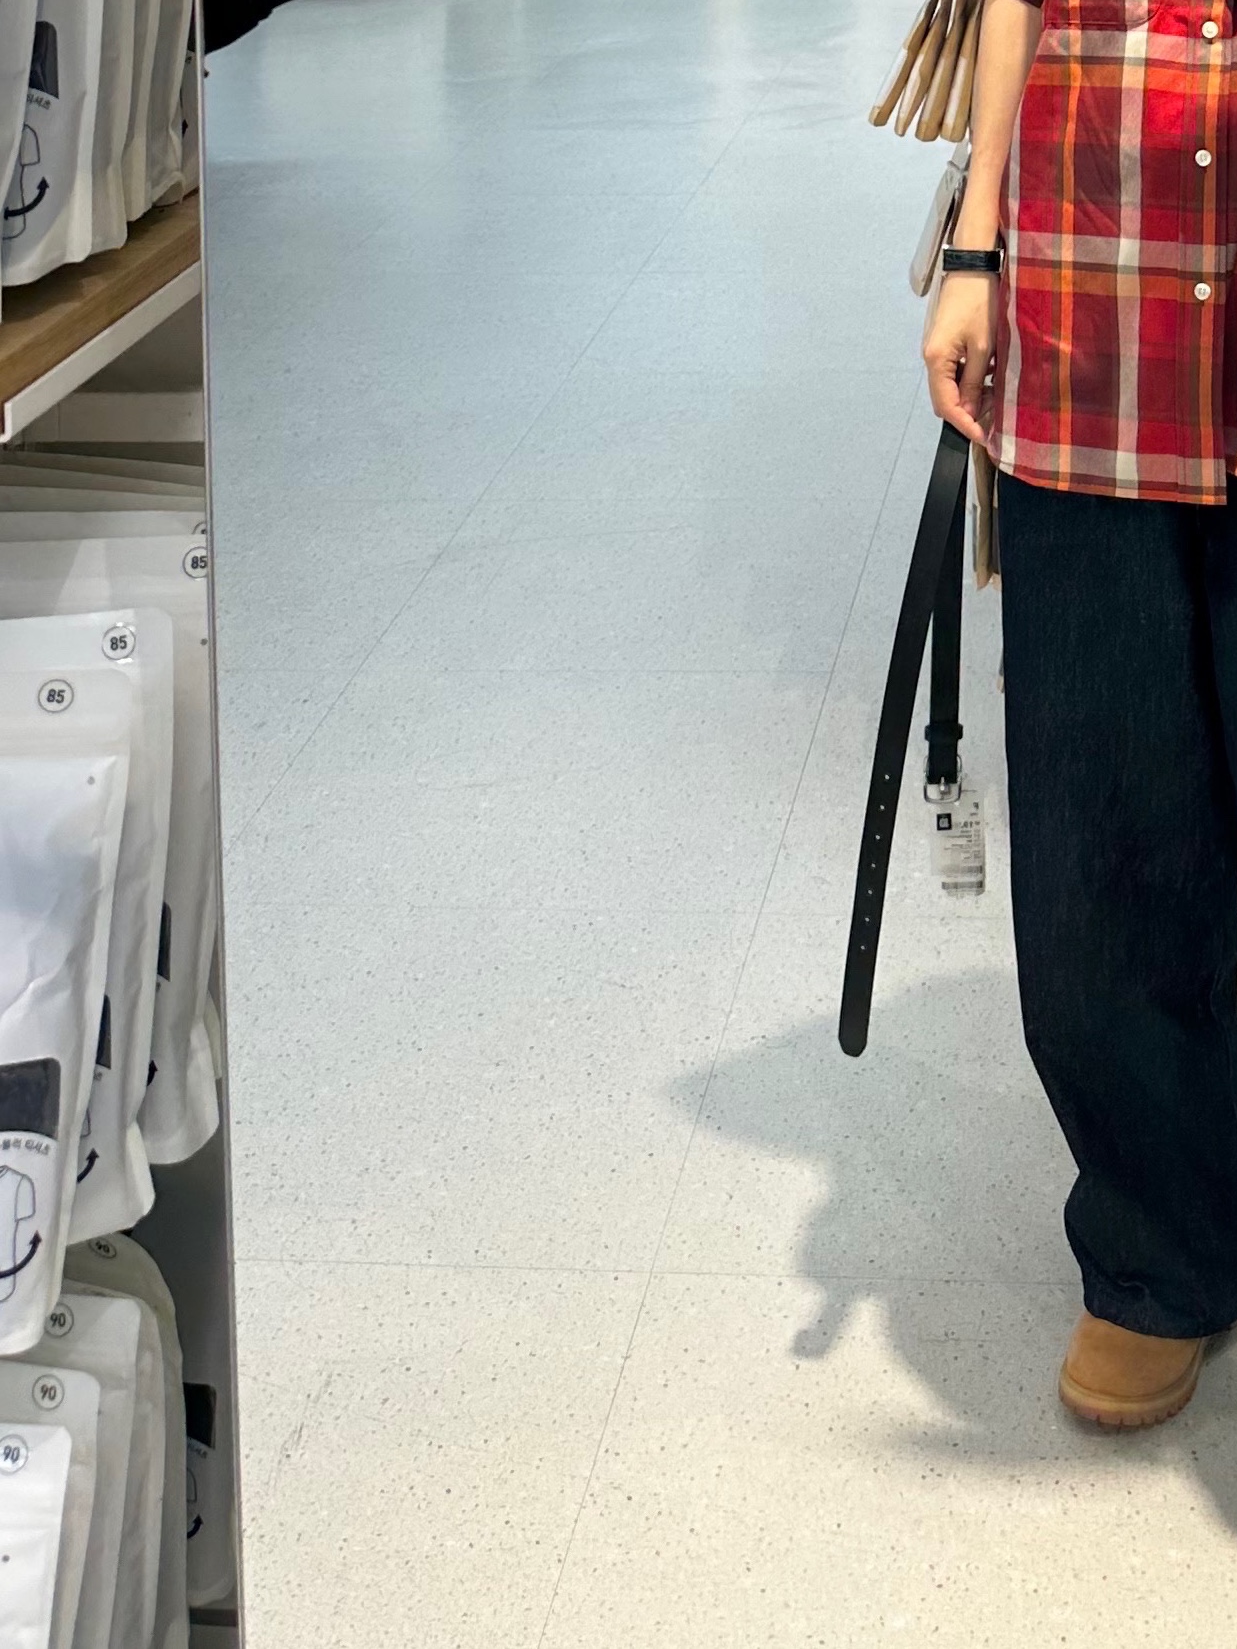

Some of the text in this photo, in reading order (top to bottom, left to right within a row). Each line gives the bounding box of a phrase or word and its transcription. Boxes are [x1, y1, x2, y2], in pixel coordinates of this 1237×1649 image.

[191, 555, 208, 570] 85
[110, 634, 127, 651] 85
[46, 688, 66, 704] 85
[50, 1312, 66, 1328] 90
[41, 1385, 56, 1401] 90
[3, 1444, 20, 1464] 90
